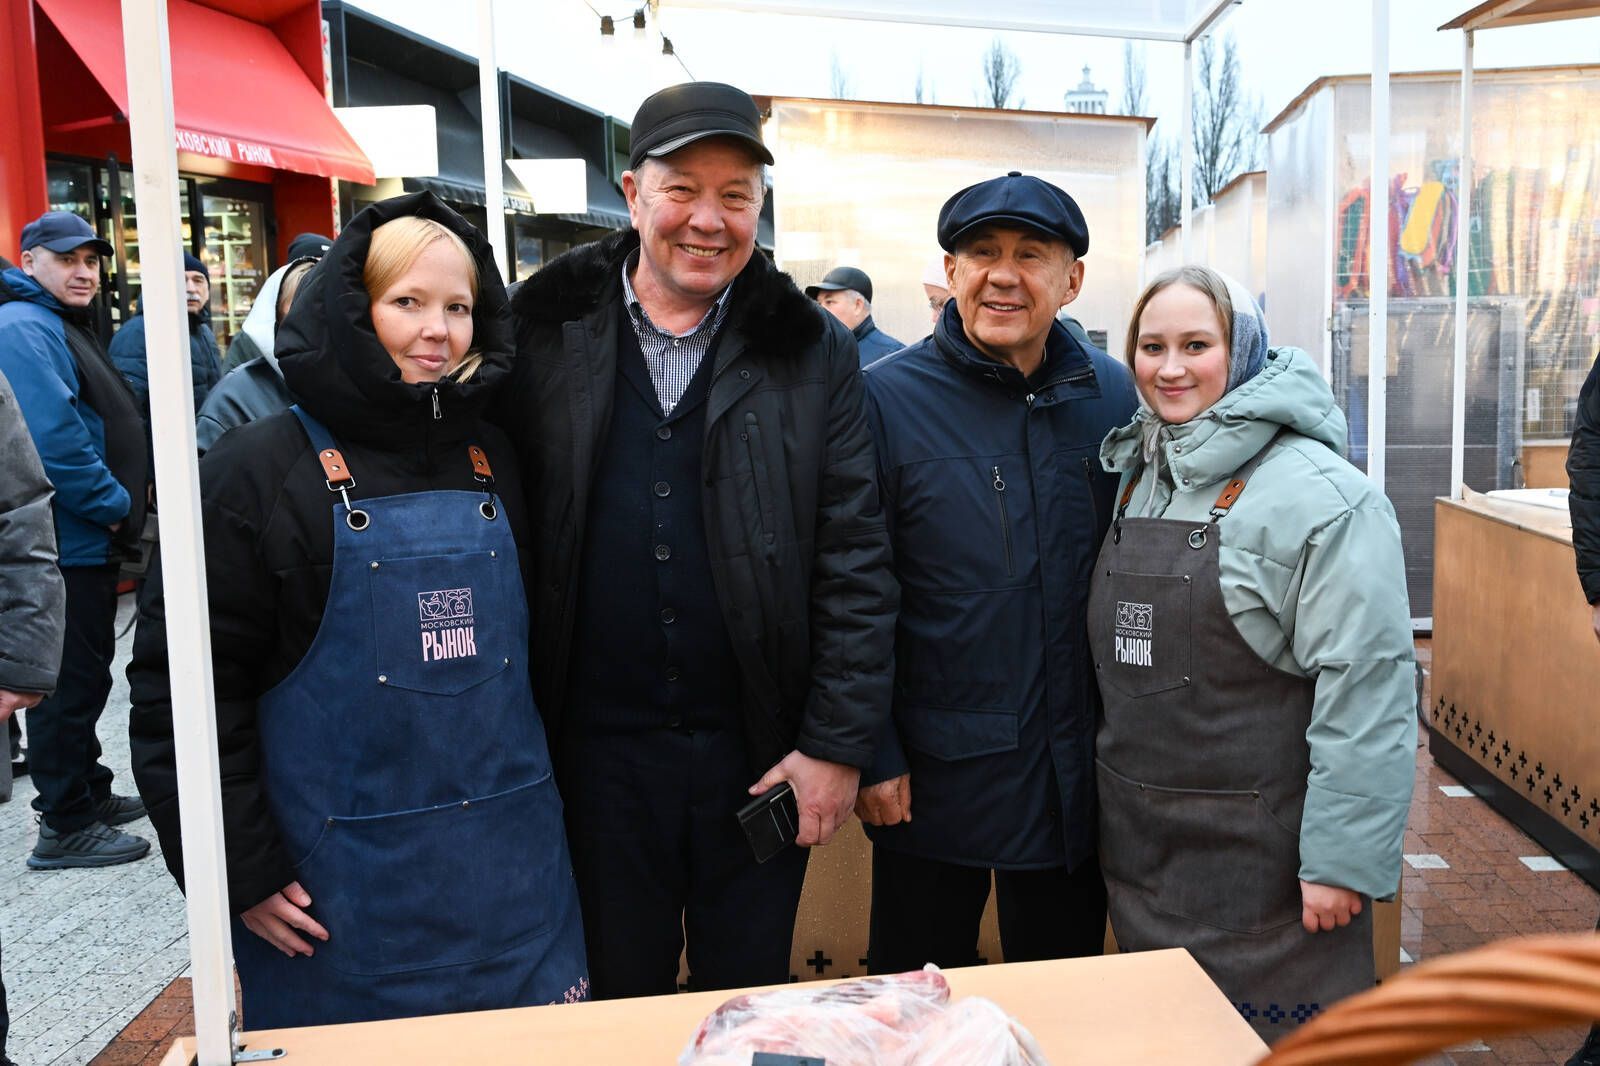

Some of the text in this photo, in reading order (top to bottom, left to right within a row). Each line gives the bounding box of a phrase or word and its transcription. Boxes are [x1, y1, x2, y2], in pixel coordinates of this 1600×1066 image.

[237, 143, 277, 165] РЫНОК
[420, 617, 474, 629] МОСКОВСКИЙ
[421, 626, 477, 662] РЫНОК
[1115, 635, 1152, 666] РЫНОК
